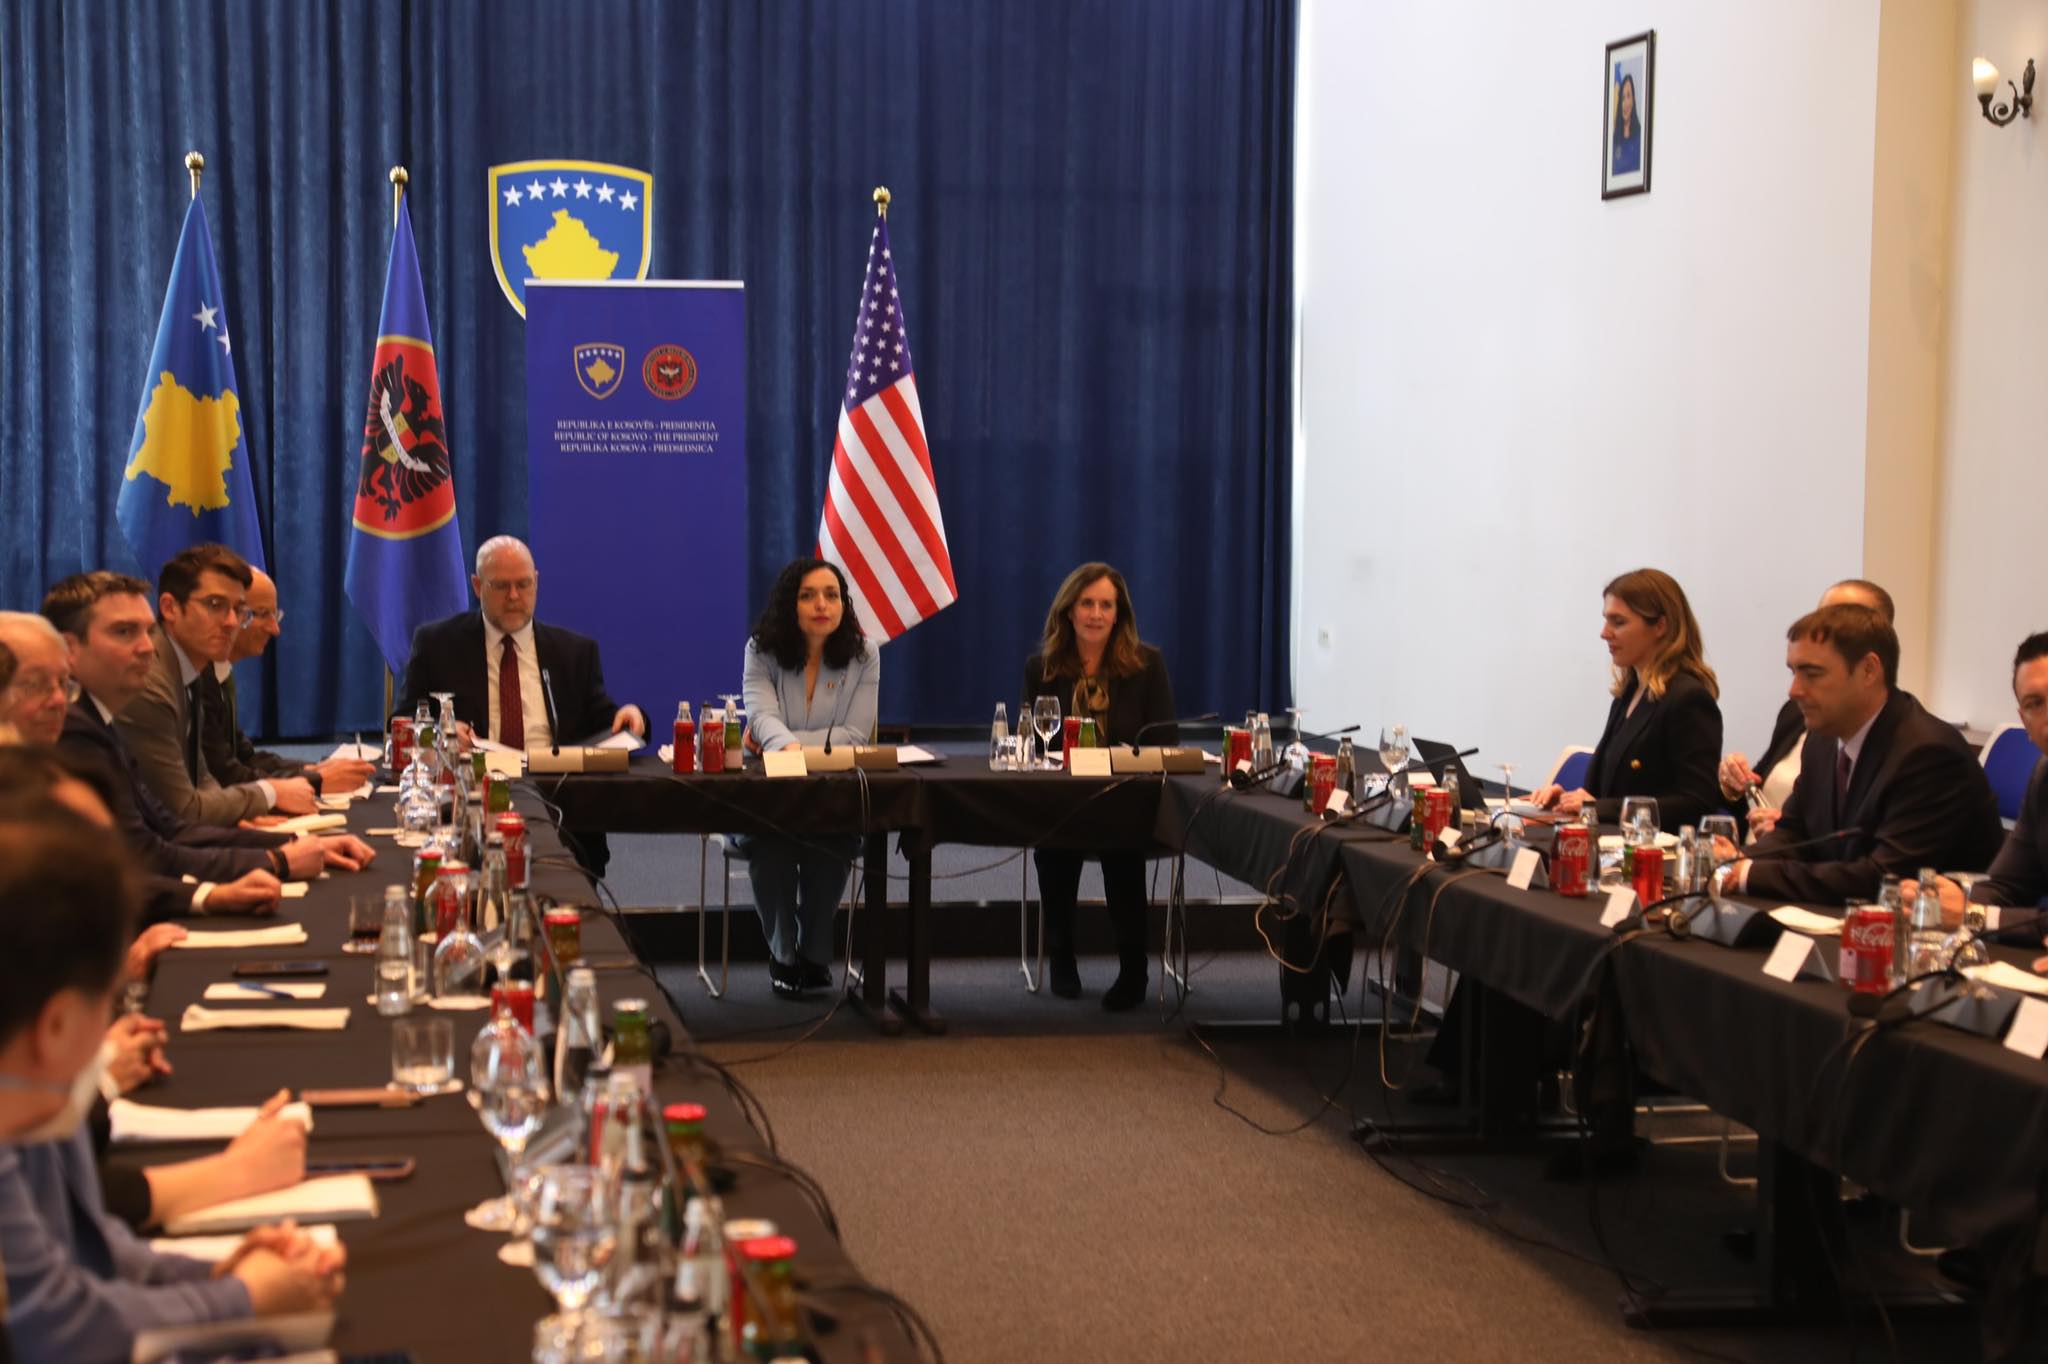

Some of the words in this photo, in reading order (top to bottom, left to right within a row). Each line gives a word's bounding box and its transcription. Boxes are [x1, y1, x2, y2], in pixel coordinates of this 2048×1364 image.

[557, 419, 605, 430] REPUBLIKA
[607, 419, 613, 430] E
[554, 431, 595, 441] REPUBLIC
[597, 431, 609, 441] OF
[611, 431, 648, 441] KOSOVO
[655, 431, 671, 442] THE
[673, 431, 720, 442] PRESIDENT
[560, 443, 609, 453] REPUBLIKA
[610, 443, 647, 453] KOSOVA
[653, 443, 713, 454] PREDSEDNICA
